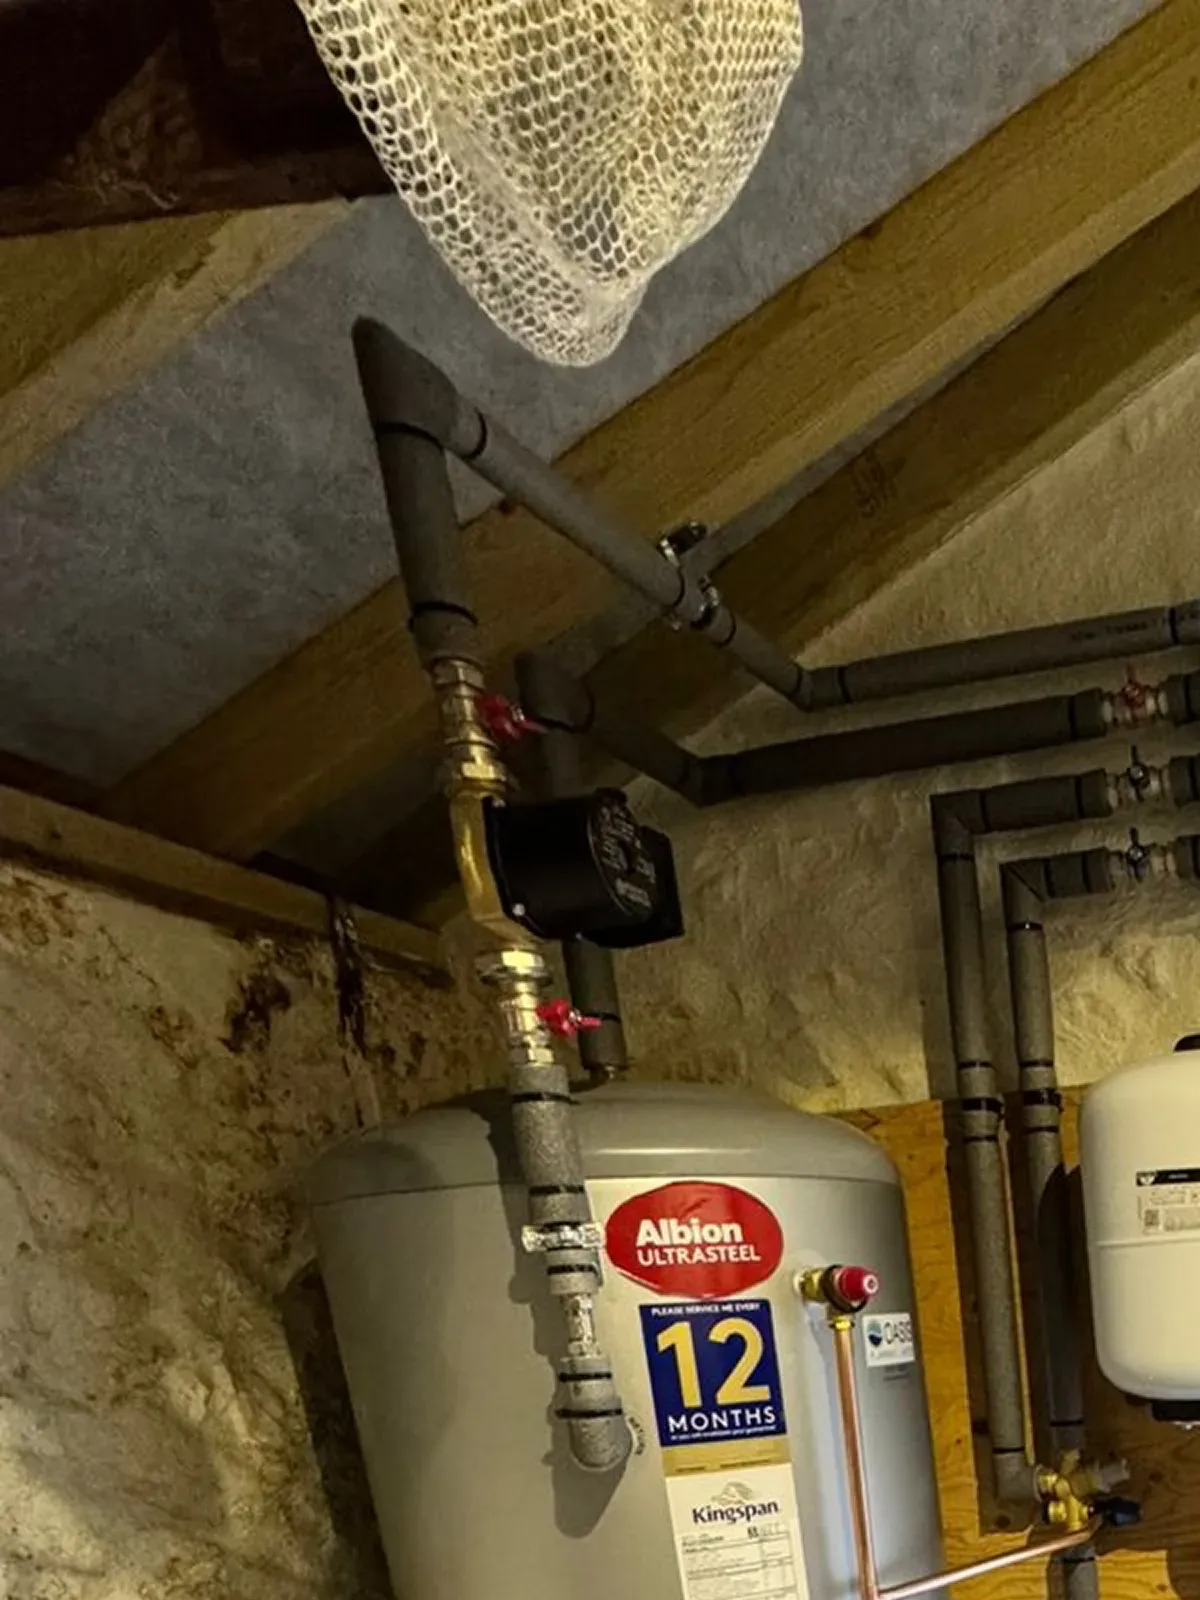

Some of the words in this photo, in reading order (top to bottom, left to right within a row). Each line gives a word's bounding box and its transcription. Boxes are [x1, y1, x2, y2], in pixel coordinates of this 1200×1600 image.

[636, 1218, 744, 1247] Albion
[637, 1244, 762, 1266] ULTRASTEEL
[657, 1317, 772, 1409] 12
[667, 1406, 777, 1433] MONTHS
[692, 1501, 780, 1525] Kingspan
